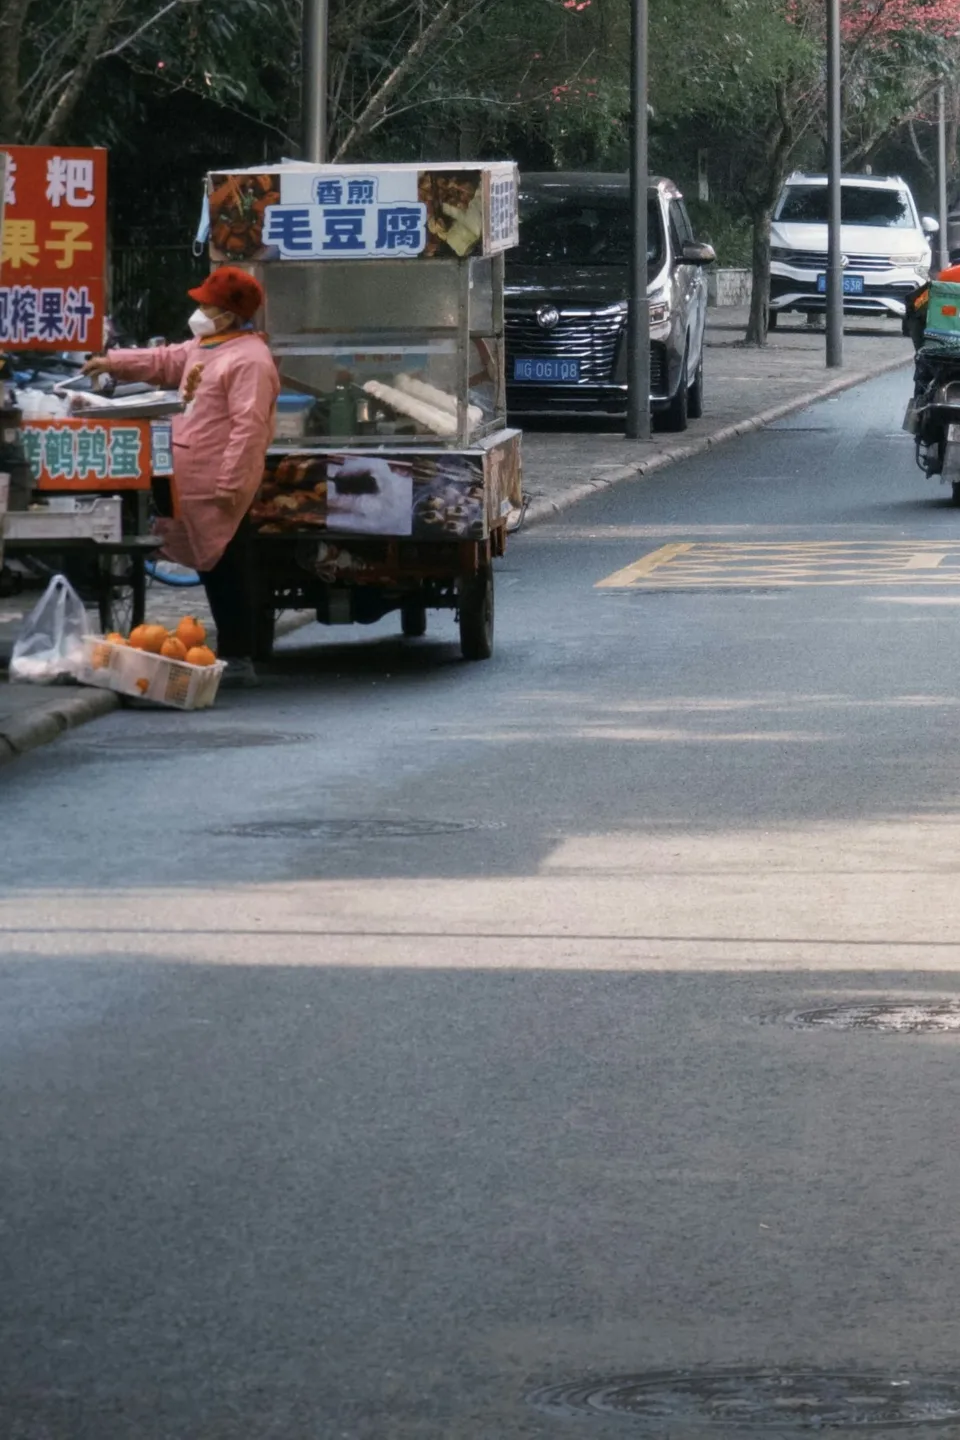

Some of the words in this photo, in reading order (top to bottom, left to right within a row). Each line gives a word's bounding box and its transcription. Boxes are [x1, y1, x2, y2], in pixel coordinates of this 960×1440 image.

[5, 152, 95, 208] 粑
[317, 179, 374, 205] 香煎
[2, 219, 93, 269] 果子
[267, 207, 422, 251] 毛豆腐
